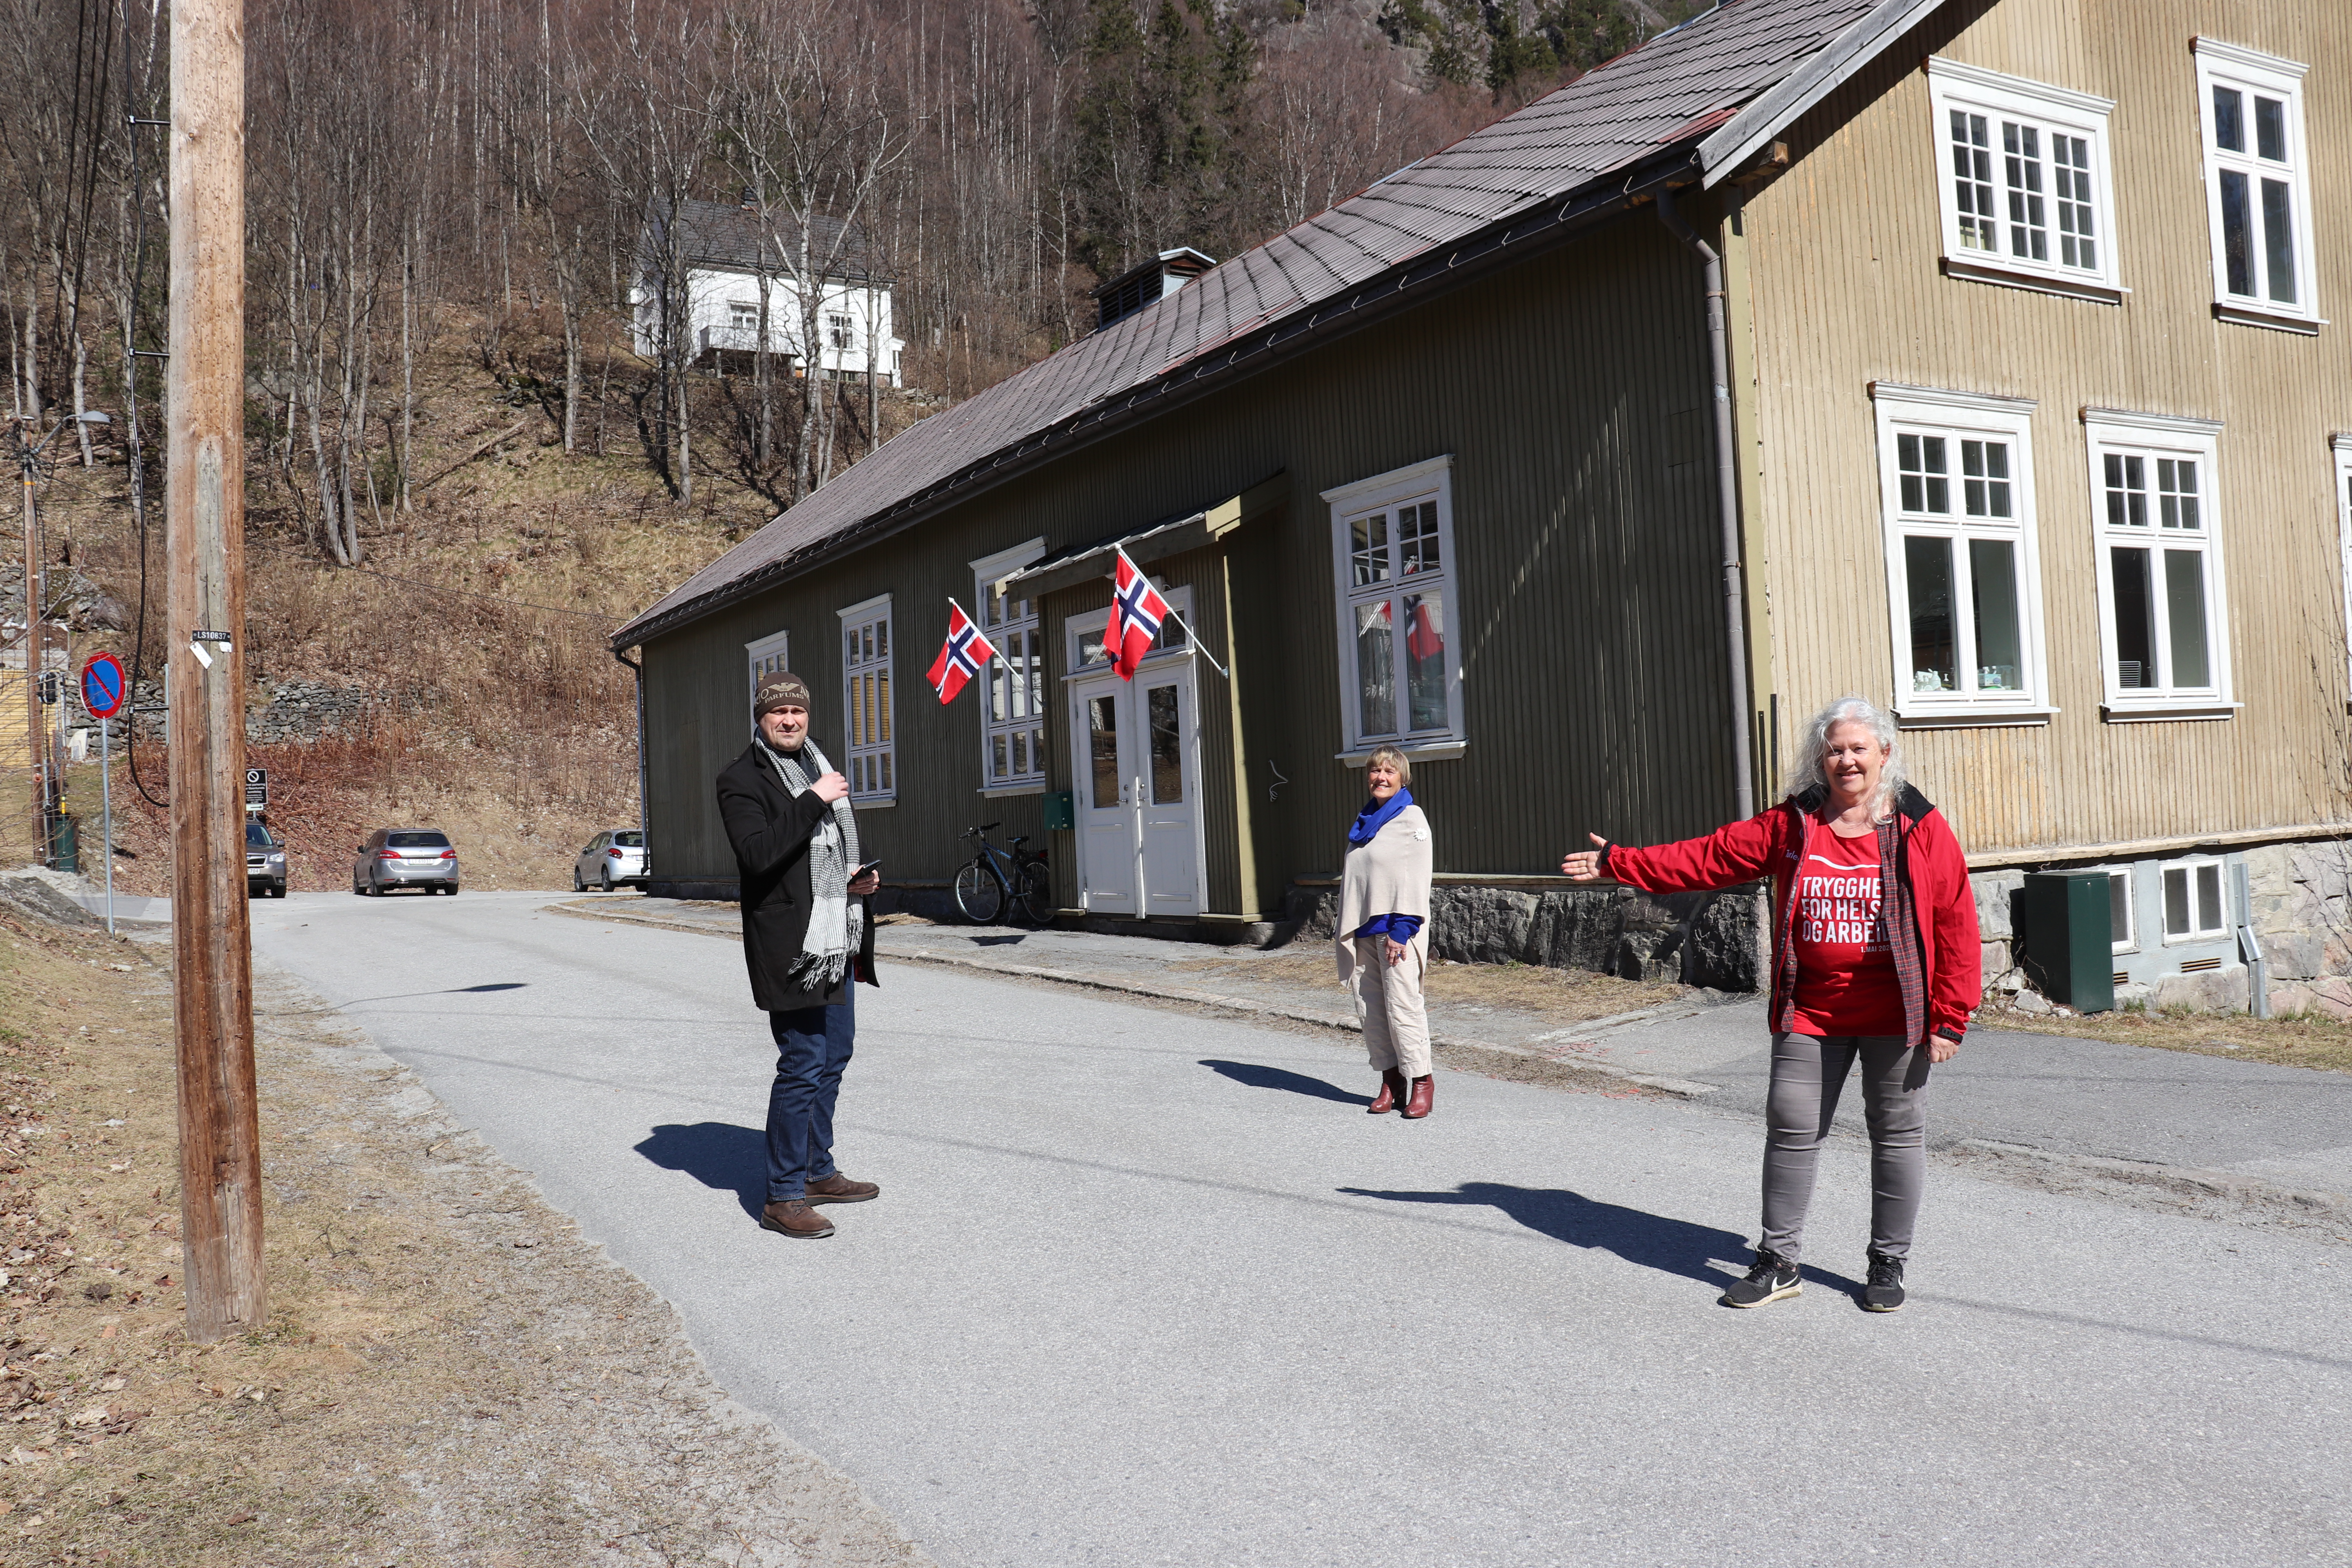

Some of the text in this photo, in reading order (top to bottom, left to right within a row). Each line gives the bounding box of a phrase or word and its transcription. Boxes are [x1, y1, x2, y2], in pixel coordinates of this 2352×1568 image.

[765, 692, 804, 704] PARFUMS
[1801, 898, 1833, 920] FOR
[1802, 920, 1823, 942] OG
